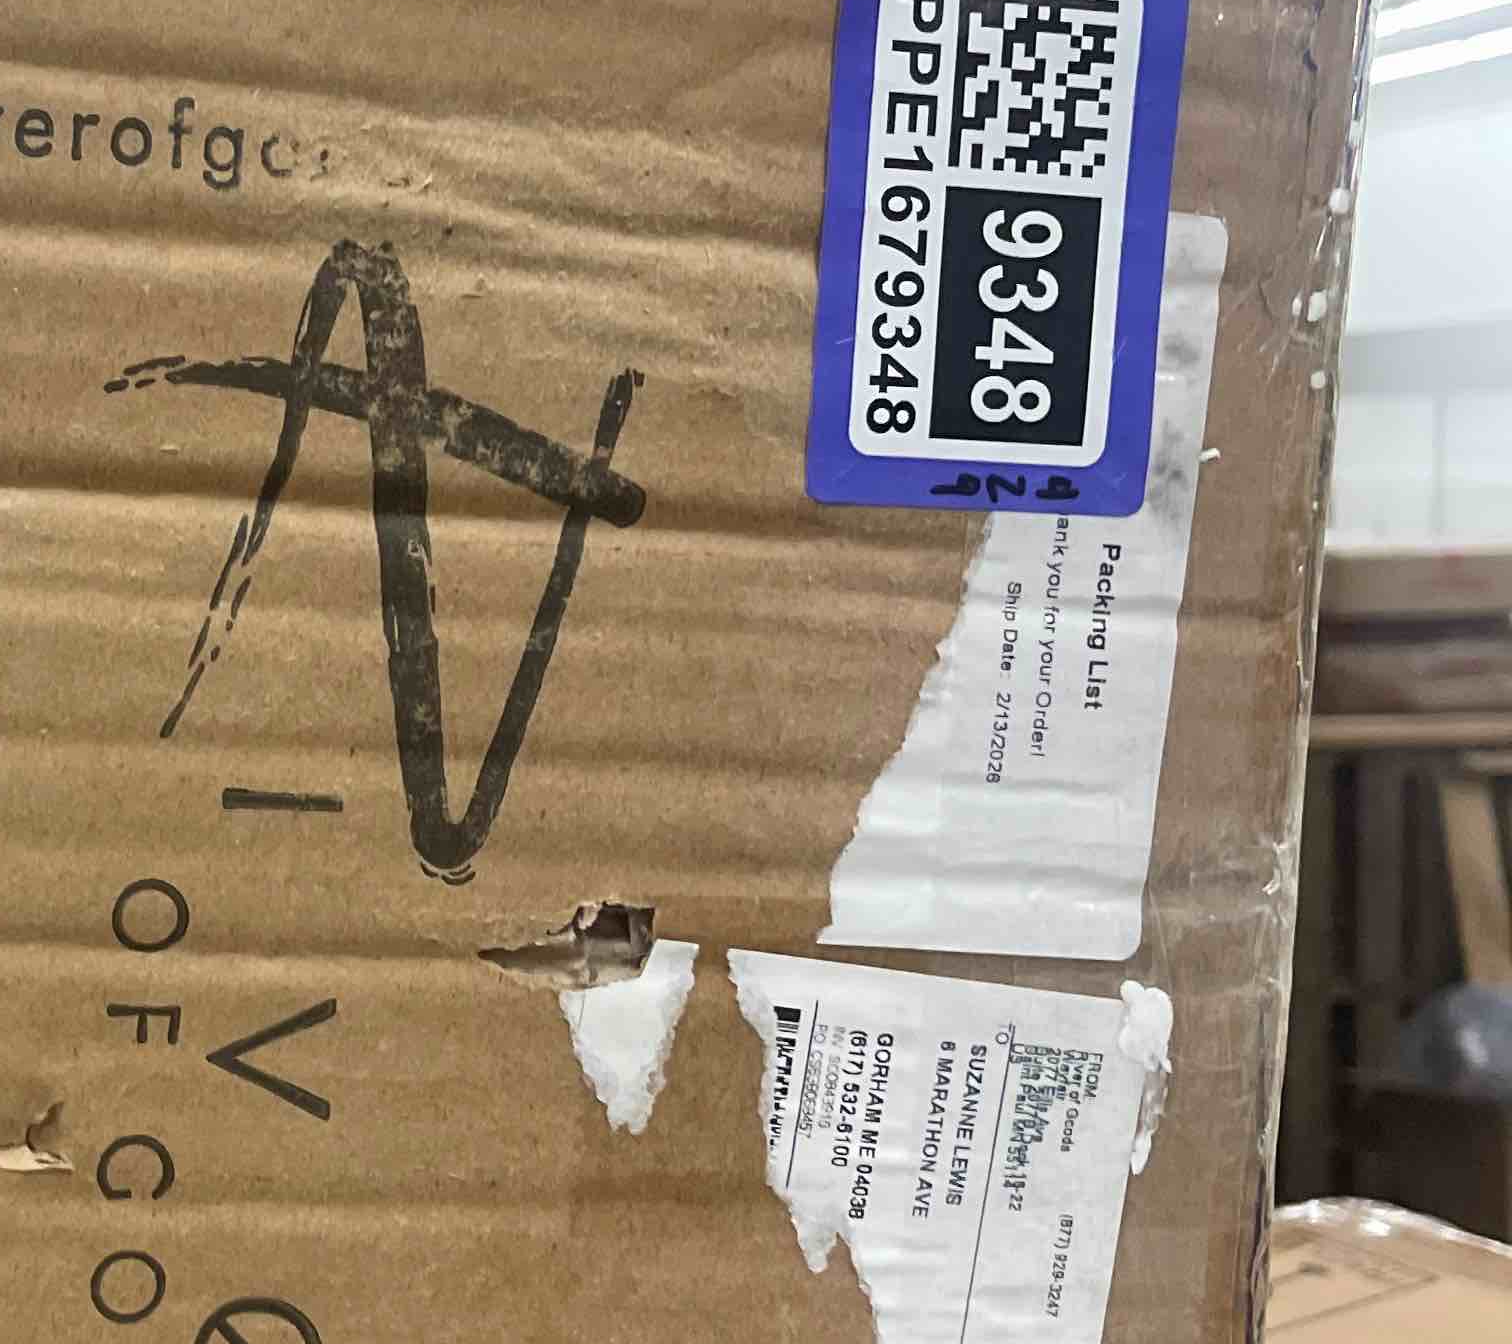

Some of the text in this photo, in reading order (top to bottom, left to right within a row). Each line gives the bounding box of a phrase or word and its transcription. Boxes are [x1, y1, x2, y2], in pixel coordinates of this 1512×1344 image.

[971, 209, 1064, 423] 9348
[1055, 513, 1069, 555] ank
[1001, 582, 1023, 623] Ship
[1045, 561, 1065, 600] you
[1042, 606, 1058, 640] for
[1083, 543, 1122, 712] Packing List
[1037, 640, 1055, 690] your
[106, 878, 190, 1046] OF
[863, 1032, 894, 1125] GORHAM
[919, 1056, 953, 1173] MARATHON
[946, 1043, 987, 1207] SUZANNE LEWIS
[858, 1128, 878, 1160] ME
[912, 1177, 934, 1219] AVE
